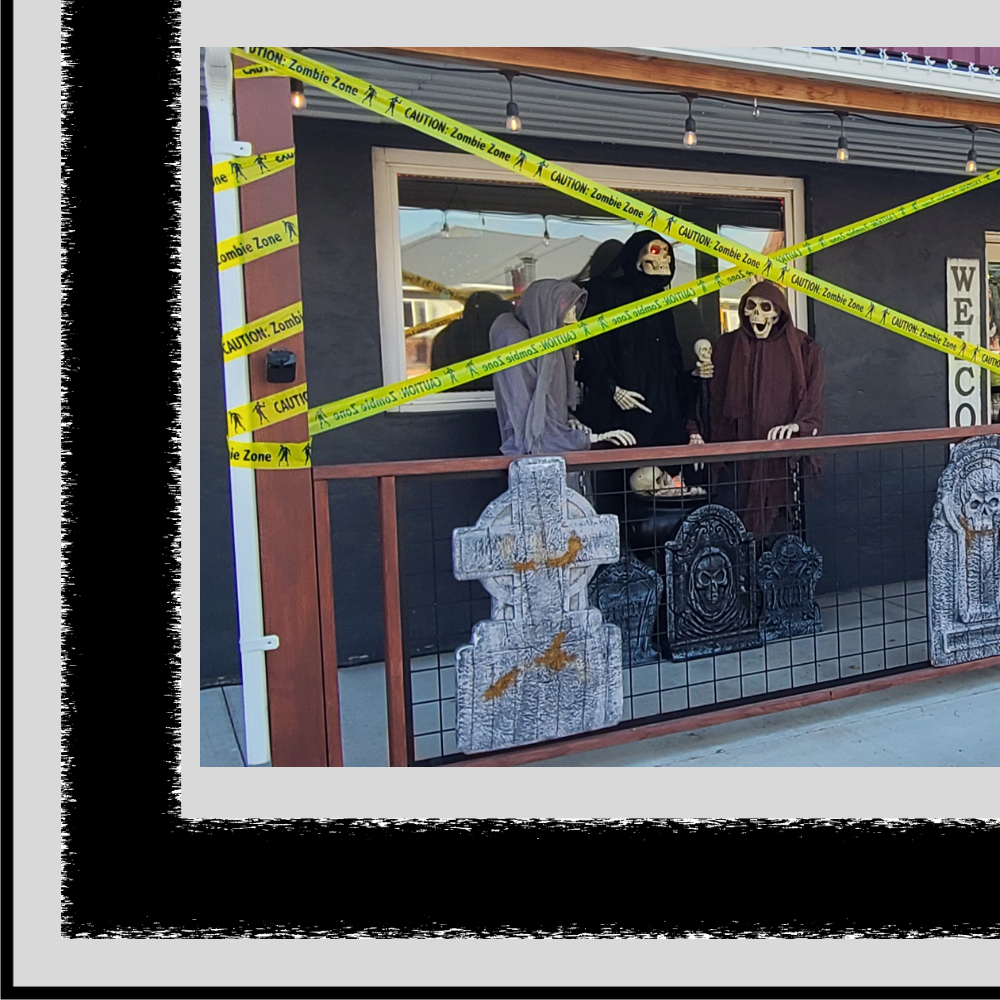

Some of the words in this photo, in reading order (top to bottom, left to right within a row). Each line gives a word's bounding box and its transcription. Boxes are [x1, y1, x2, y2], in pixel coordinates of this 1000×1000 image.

[243, 47, 286, 67] UTION:
[288, 59, 329, 84] Zombie
[332, 76, 358, 96] Zone
[404, 107, 449, 134] CAUTION:
[450, 127, 486, 151] Zombie
[487, 143, 511, 161] Zone
[550, 170, 589, 195] CAUTION:
[590, 188, 622, 209] Zombie
[623, 202, 644, 219] Zone
[252, 233, 282, 249] Zone
[678, 225, 713, 248] CAUTION:
[713, 241, 741, 260] Zombie
[742, 253, 761, 269] Zone
[791, 274, 822, 295] CAUTION:
[822, 287, 847, 306] Zombie
[848, 298, 864, 312] Zone
[270, 311, 303, 334] Zombi
[891, 316, 919, 336] CAUTION:
[919, 328, 942, 345] Zombie
[942, 338, 957, 351] Zone
[243, 450, 272, 462] Zone
